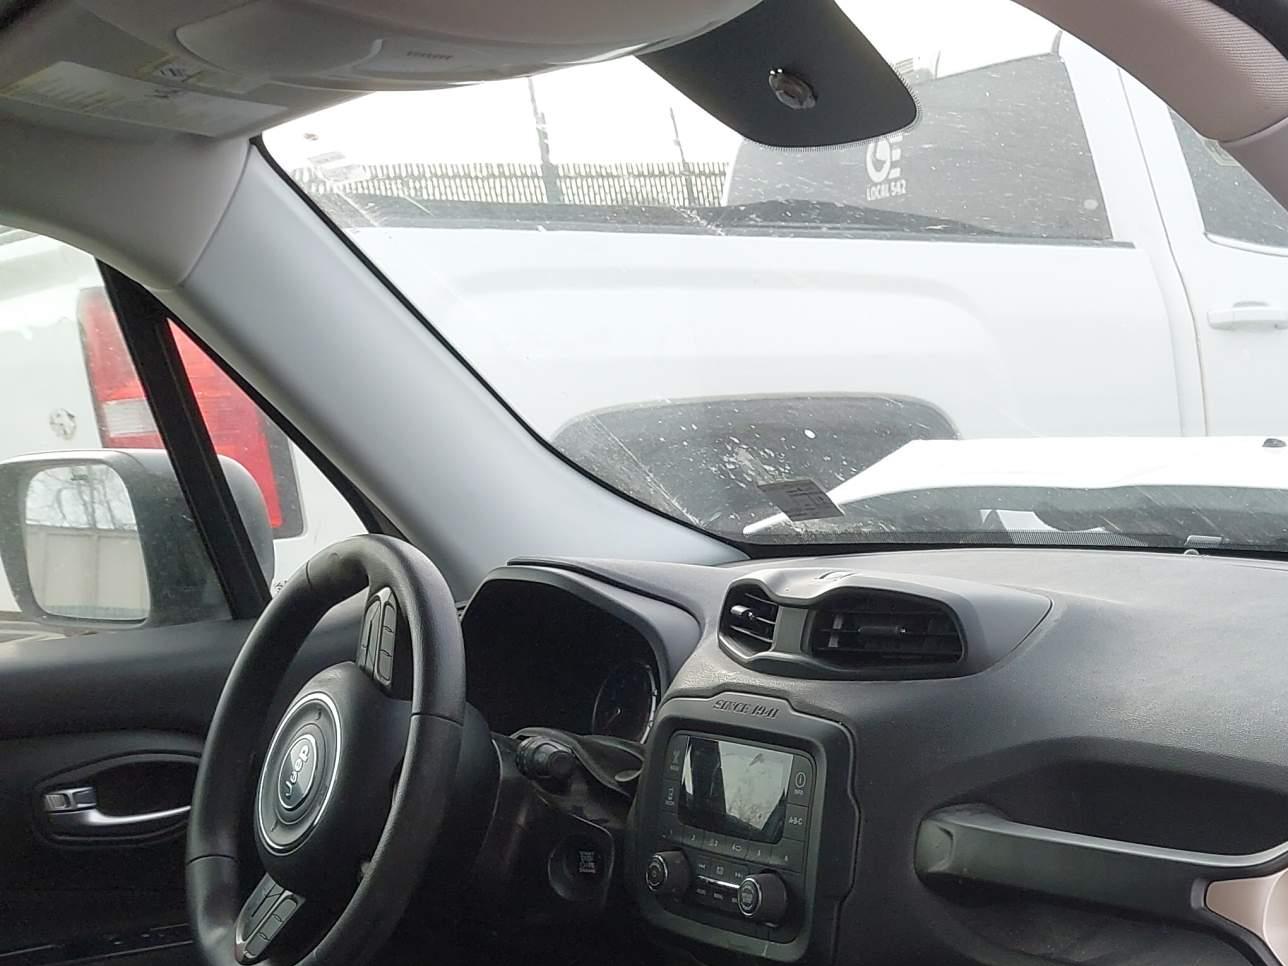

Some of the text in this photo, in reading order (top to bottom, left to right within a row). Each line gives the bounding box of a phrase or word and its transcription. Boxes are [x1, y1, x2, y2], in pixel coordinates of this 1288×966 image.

[866, 179, 906, 201] LOCAL 542
[713, 699, 779, 718] SINCE 1941
[285, 744, 309, 797] Jeep
